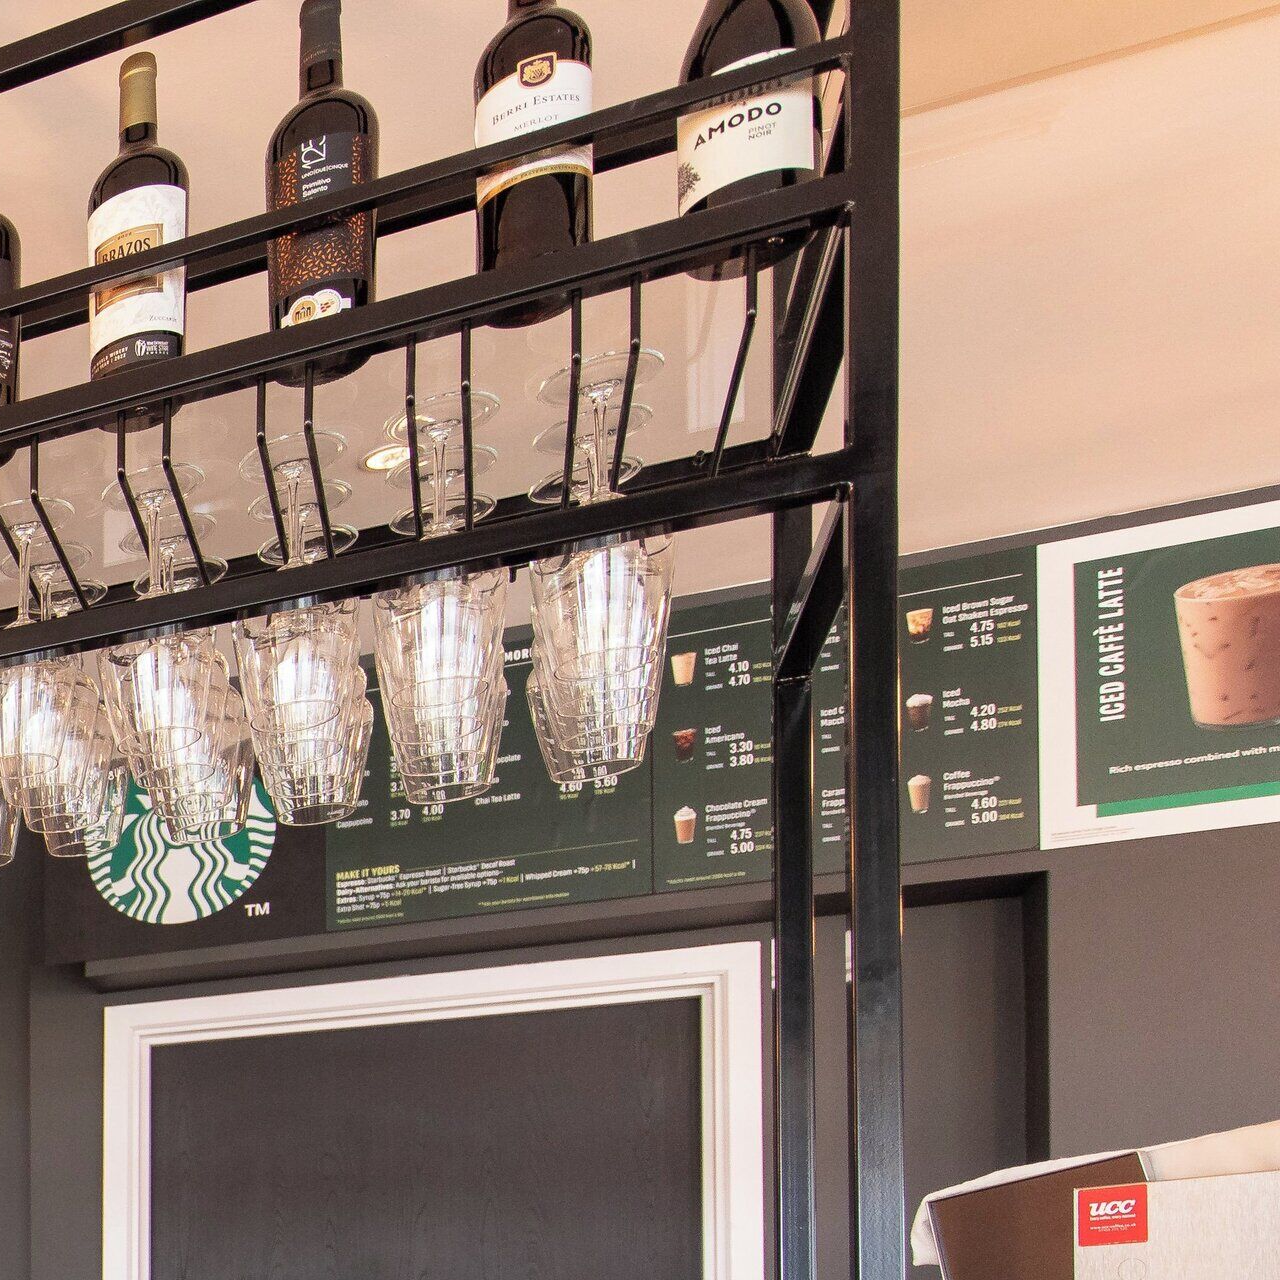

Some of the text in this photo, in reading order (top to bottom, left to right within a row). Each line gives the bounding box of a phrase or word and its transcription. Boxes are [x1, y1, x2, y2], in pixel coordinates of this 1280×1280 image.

[491, 94, 580, 126] BERRI ESTATES
[513, 114, 560, 132] MERLOT
[694, 102, 782, 151] AMODO
[748, 121, 777, 134] PINOT
[748, 129, 772, 141] NOIR
[302, 177, 331, 191] Primitivo
[302, 185, 328, 198] Salento
[942, 595, 1016, 614] Iced Brown Sugar
[958, 610, 989, 622] Shaken
[989, 603, 1029, 617] Espresso
[969, 620, 995, 633] 4.75
[970, 633, 994, 648] 5.15
[1093, 566, 1126, 722] ICED CAFFÈ LATTE
[704, 642, 739, 656] Iced Chai
[705, 653, 738, 666] Tea Latte
[728, 660, 750, 673] 4.10
[728, 673, 751, 687] 4.70
[943, 688, 961, 699] Iced
[943, 697, 971, 709] Mocha
[820, 707, 837, 717] Iced
[969, 703, 996, 718] 4.20
[820, 717, 845, 727] Macch
[970, 717, 997, 732] 4.80
[705, 725, 722, 735] Iced
[705, 732, 746, 745] Americano
[729, 740, 754, 755] 3.30
[730, 753, 754, 768] 3.80
[1108, 763, 1133, 775] Rich
[1134, 758, 1183, 772] espresso
[1183, 749, 1240, 765] combined
[1241, 745, 1268, 757] with
[943, 770, 971, 781] Coffee
[559, 782, 583, 792] 4.60
[594, 775, 618, 788] 5.60
[475, 792, 521, 806] Chai Tea Latte
[822, 787, 846, 798] Caram
[705, 797, 768, 814] Chocolate Cream
[971, 796, 998, 810] 4.60
[391, 804, 444, 821] 3.70 4.00
[971, 810, 998, 825] 5.00
[336, 817, 373, 829] Cappuccino
[730, 827, 753, 841] 4.75
[730, 841, 755, 855] 5.00
[336, 864, 400, 881] MAKE IT YOURS
[481, 861, 498, 870] Decaf
[358, 893, 375, 903] Syrup
[464, 879, 481, 889] Syrup
[525, 871, 552, 881] Whipped
[552, 868, 573, 878] Cream
[573, 866, 590, 876] +75p
[406, 880, 420, 890] your
[336, 904, 352, 913] Extra
